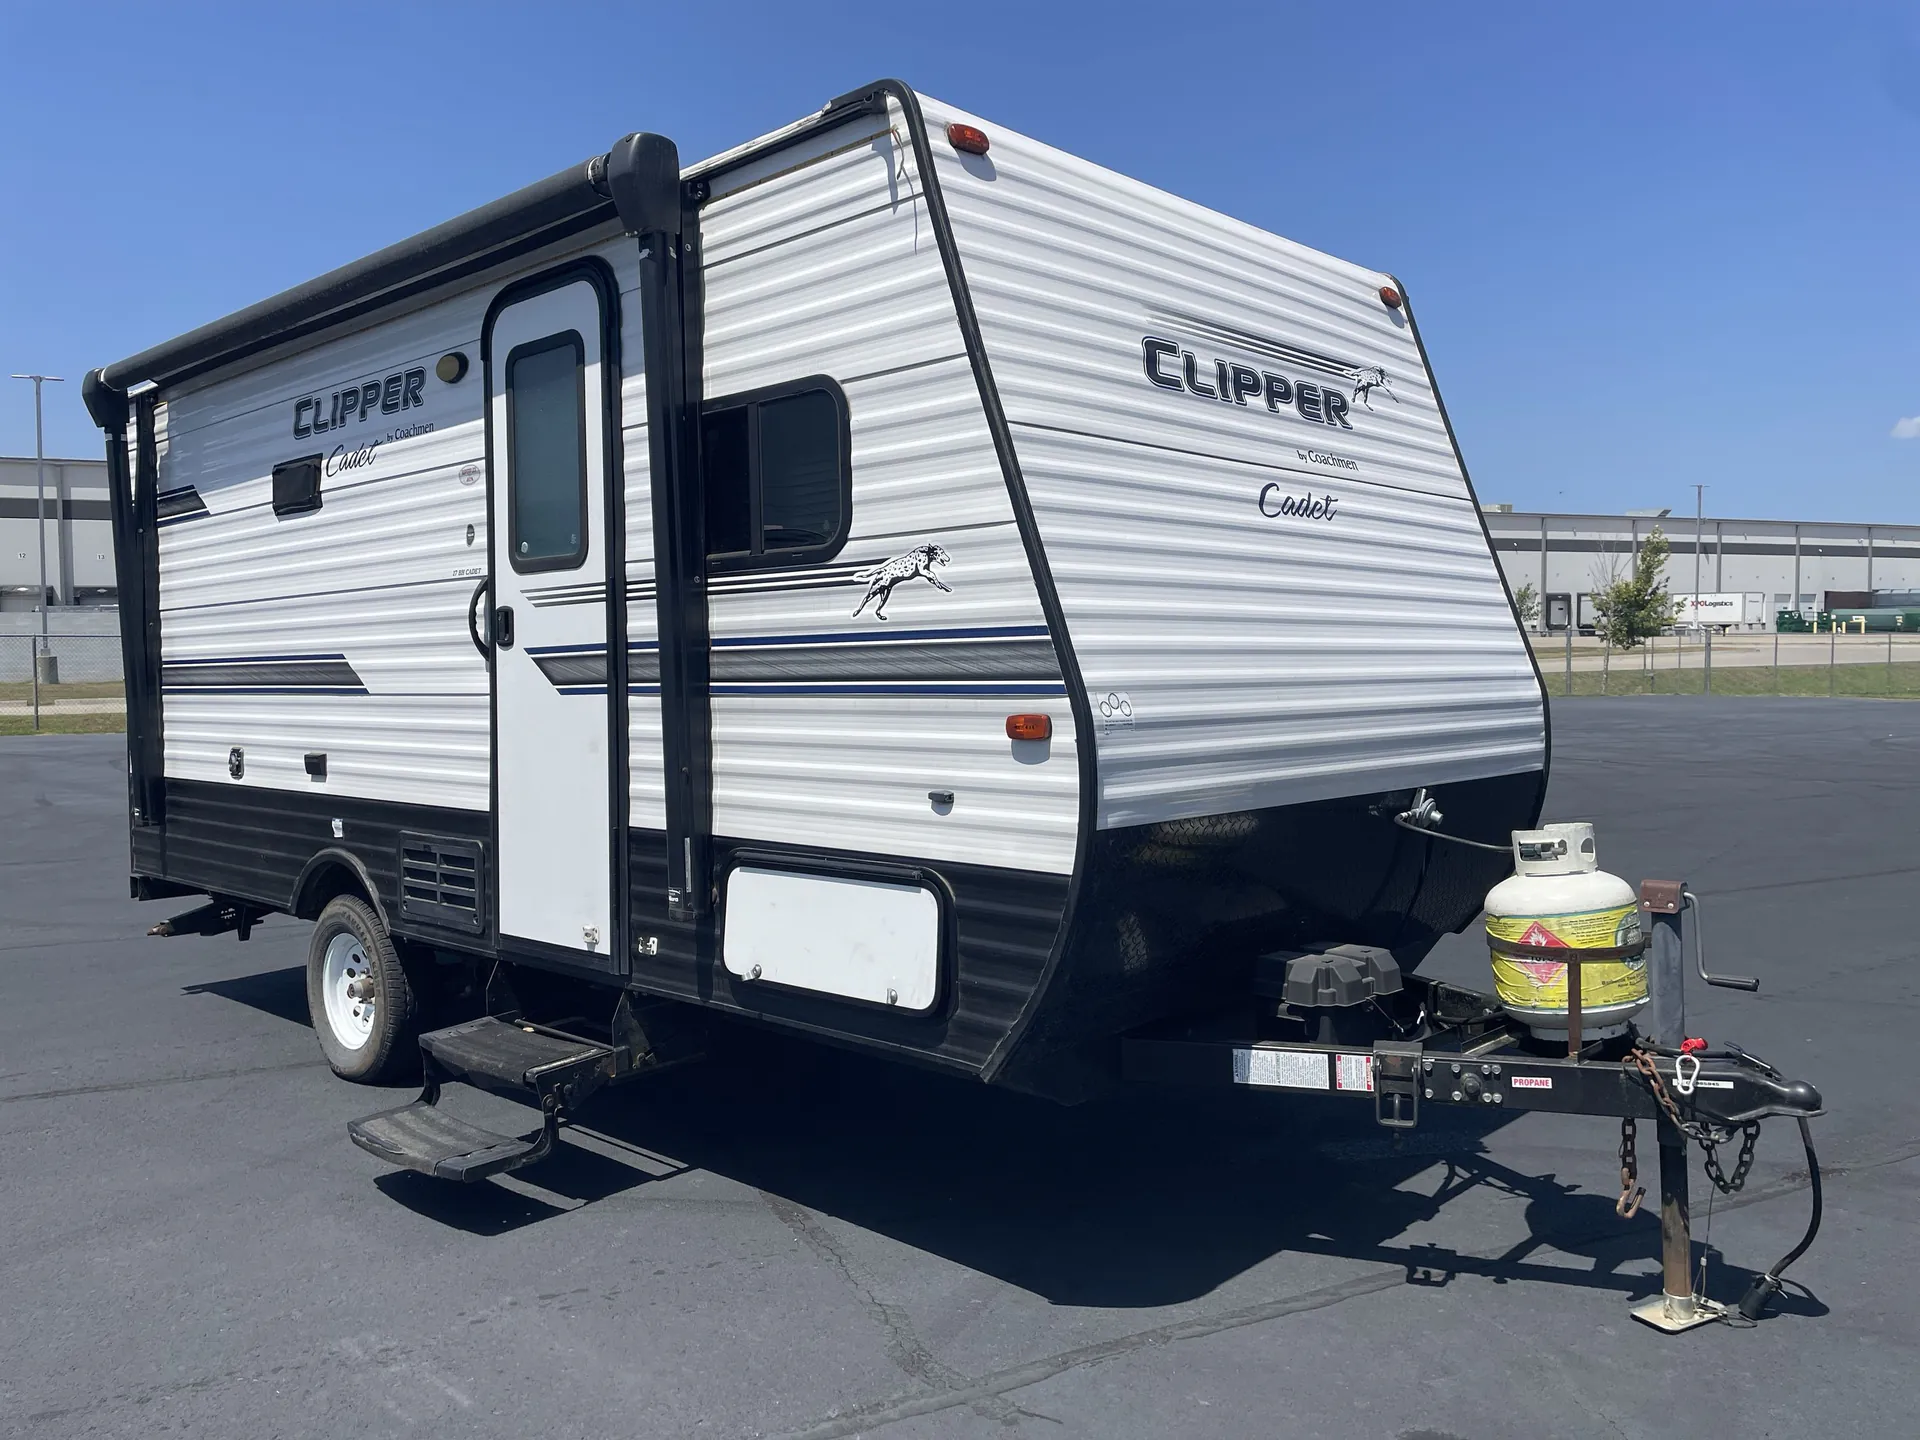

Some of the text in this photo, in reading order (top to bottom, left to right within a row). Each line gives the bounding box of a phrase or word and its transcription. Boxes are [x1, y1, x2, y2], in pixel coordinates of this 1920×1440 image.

[1142, 336, 1353, 430] CLIPPER
[293, 366, 427, 440] CLIPPER
[387, 422, 434, 442] by Coachmen
[325, 440, 384, 477] Cadet
[1296, 449, 1359, 471] by Coachmen
[1258, 482, 1339, 521] Cadet
[1513, 1078, 1550, 1087] PROPANE
